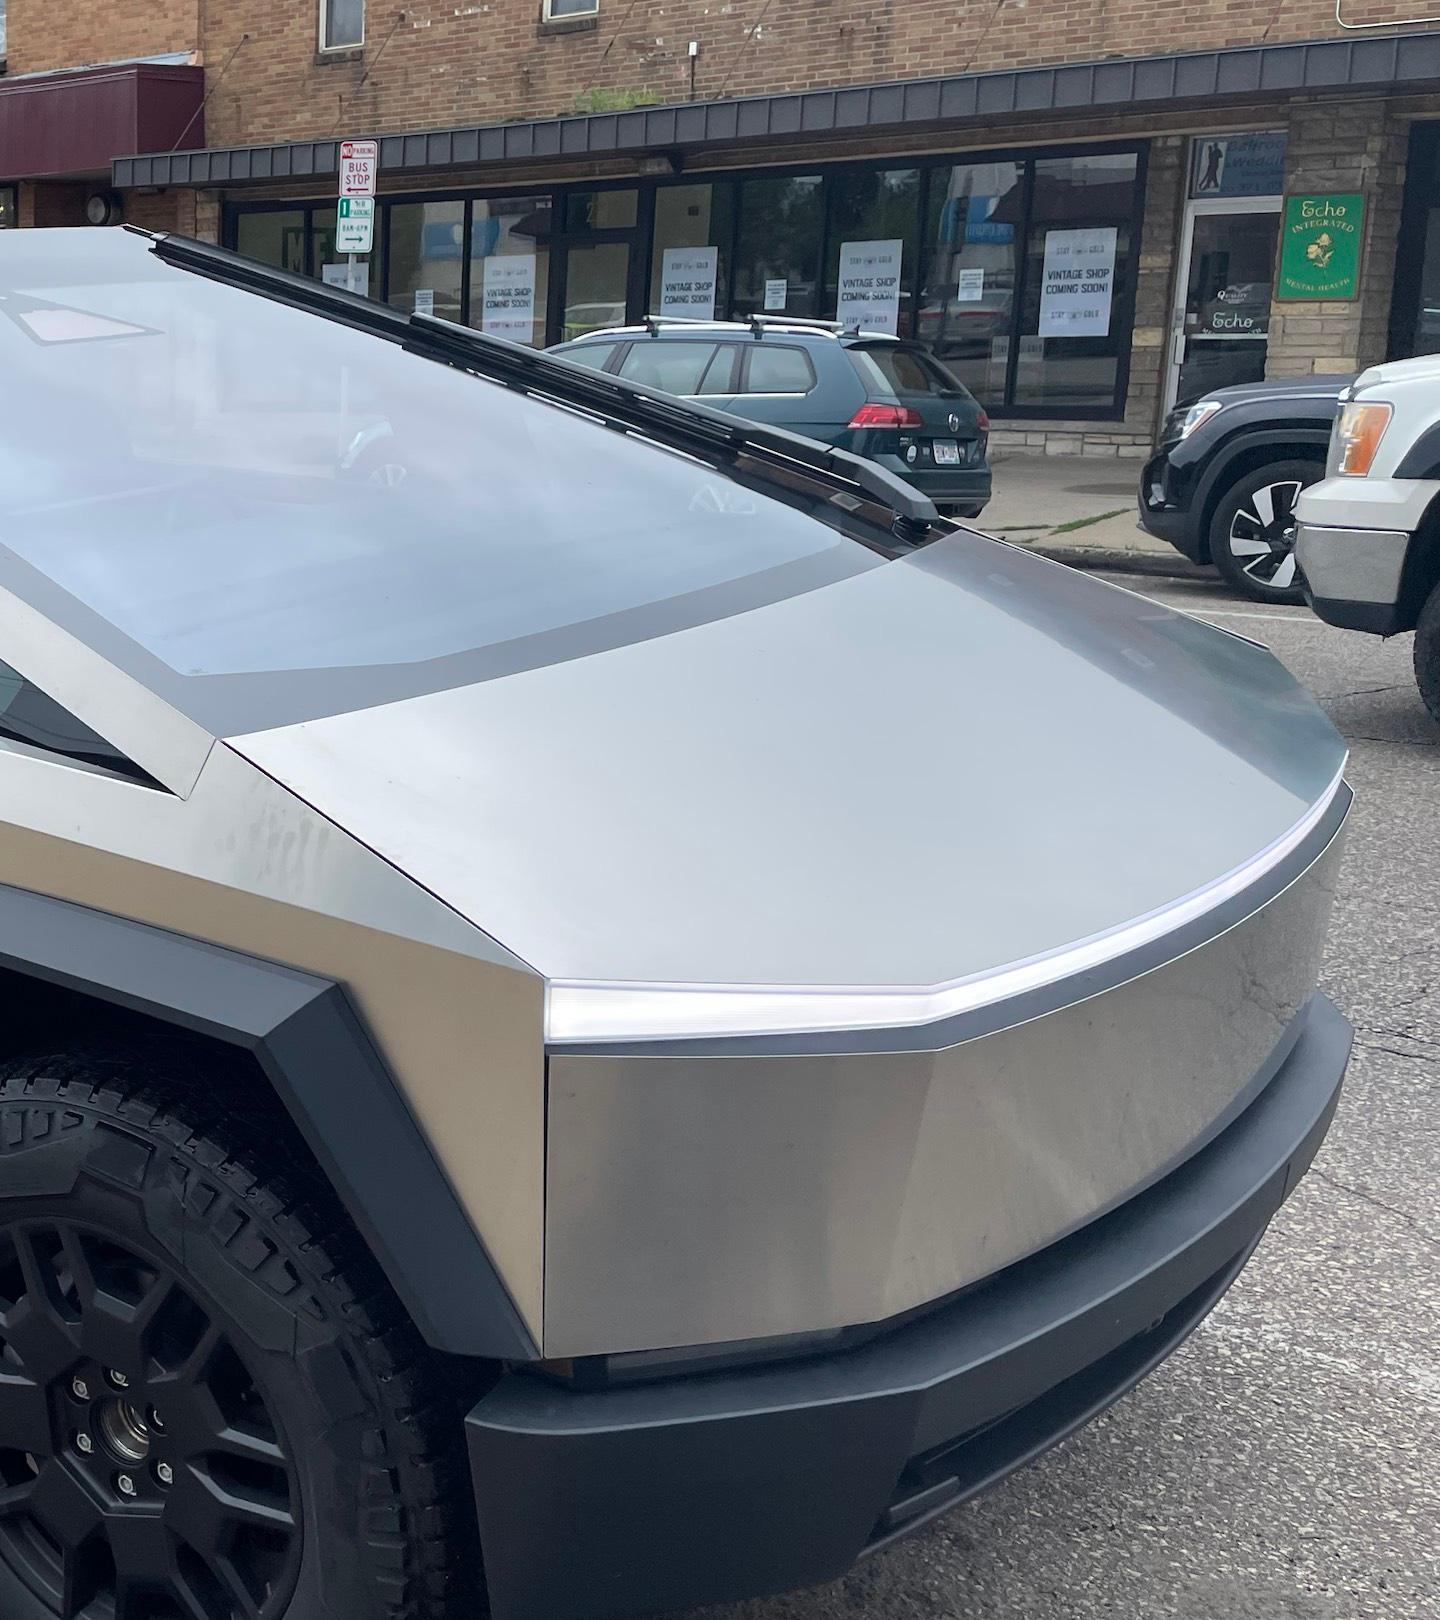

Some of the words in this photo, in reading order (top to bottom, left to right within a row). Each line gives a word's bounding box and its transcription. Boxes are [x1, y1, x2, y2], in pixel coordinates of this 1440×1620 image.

[342, 145, 352, 156] NO
[348, 162, 368, 172] BUS
[345, 174, 370, 185] STOP
[342, 201, 347, 216] 1
[1301, 200, 1346, 218] Echo
[1292, 219, 1354, 234] INTEGRATED
[1047, 269, 1083, 280] VINTAGE
[1086, 268, 1110, 279] SHOP
[665, 282, 692, 291] VINTAGE
[694, 281, 713, 291] SHOP
[842, 277, 873, 288] VINTAGE
[876, 277, 897, 287] SHOP
[1046, 283, 1078, 294] COMING
[1081, 282, 1108, 294] SOON!
[1286, 278, 1315, 292] MENTAL
[1318, 277, 1350, 291] HEALTH
[486, 287, 512, 297] VINTAGE
[514, 287, 532, 296] SHOP
[841, 291, 870, 302] COMING
[486, 300, 510, 309] COMING
[664, 295, 689, 304] COMING
[1212, 311, 1254, 328] Echo
